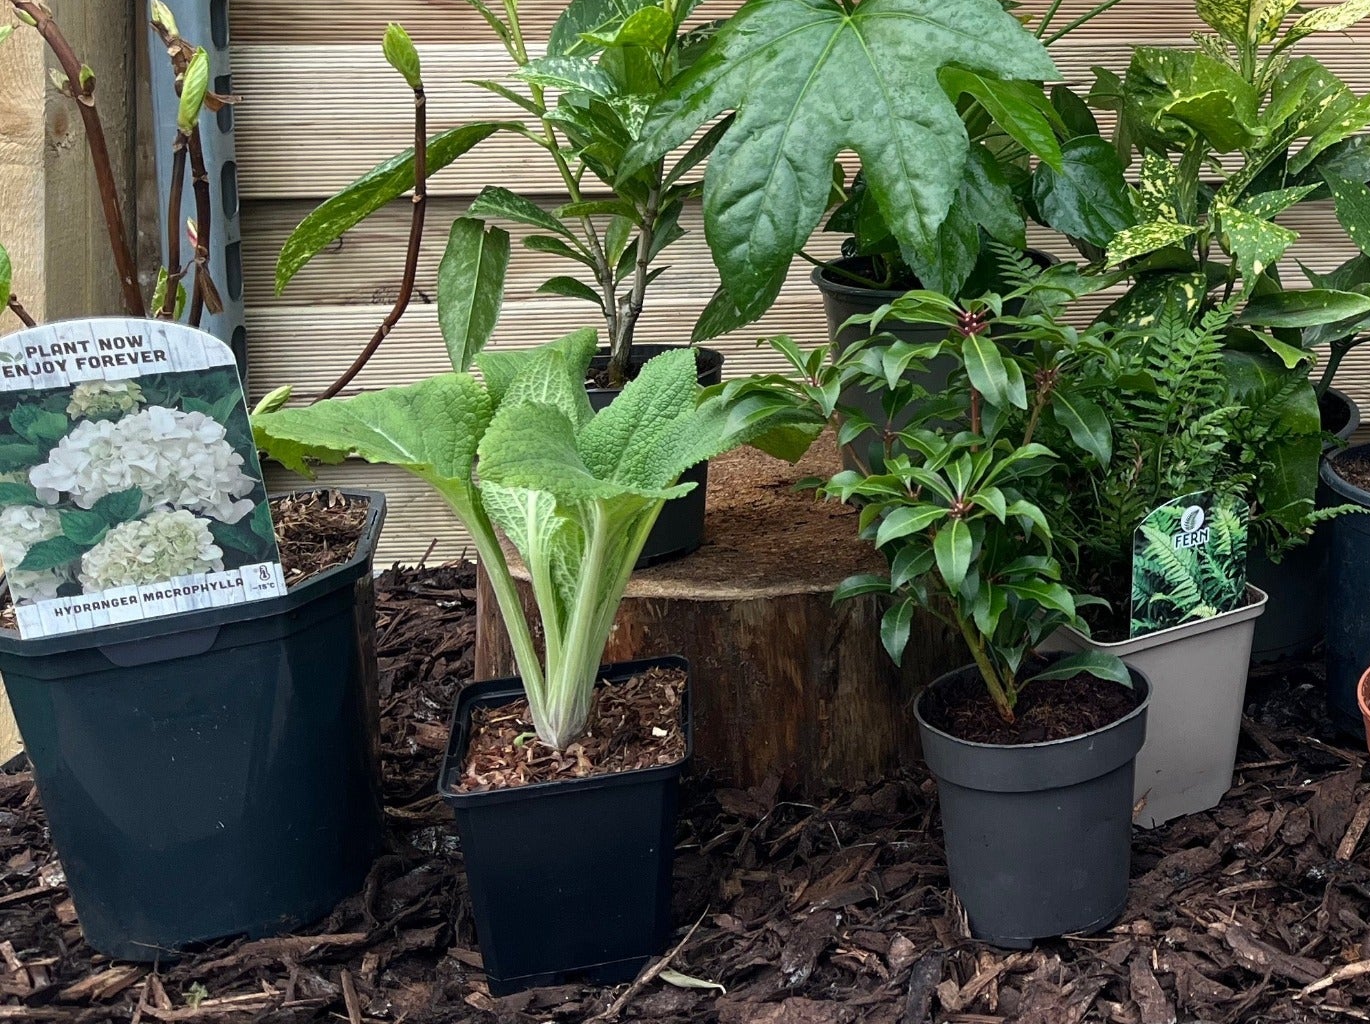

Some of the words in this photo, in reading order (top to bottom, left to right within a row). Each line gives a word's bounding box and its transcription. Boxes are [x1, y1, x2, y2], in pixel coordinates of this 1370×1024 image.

[25, 340, 90, 358] PLANT
[98, 335, 143, 351] NOW
[2, 359, 67, 378] ENJOY
[76, 350, 167, 370] FOREVER
[1175, 530, 1209, 548] FERN
[54, 596, 138, 617] HYDRANGEA
[143, 578, 244, 602] MACROPHYLLA
